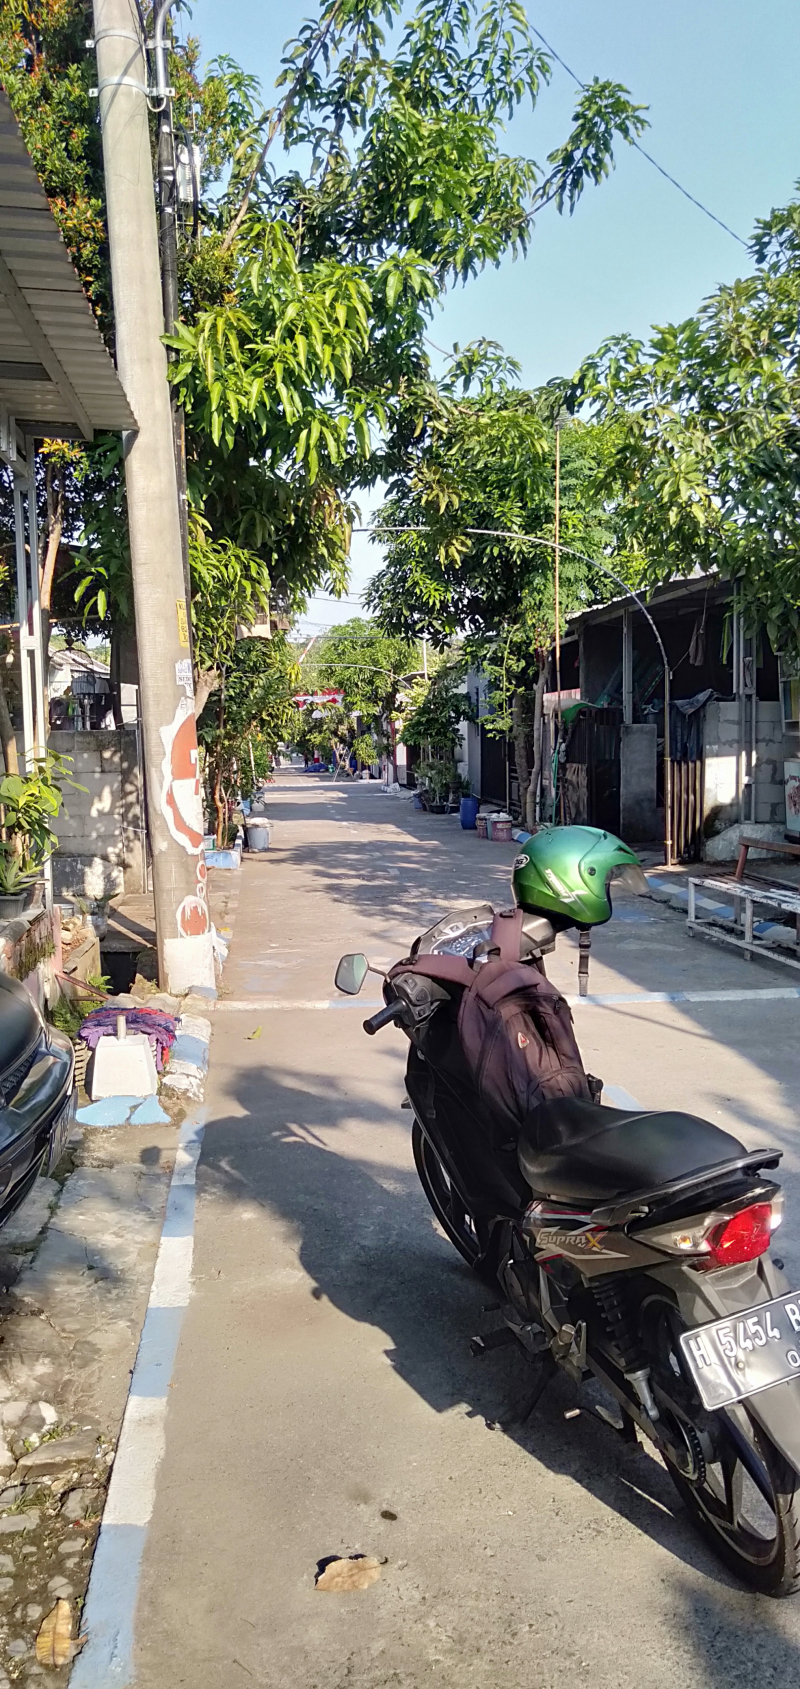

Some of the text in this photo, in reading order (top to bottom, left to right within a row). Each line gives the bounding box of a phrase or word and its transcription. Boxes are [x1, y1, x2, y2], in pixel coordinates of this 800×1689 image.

[584, 1230, 609, 1251] X
[688, 1299, 800, 1369] H 5454 B
